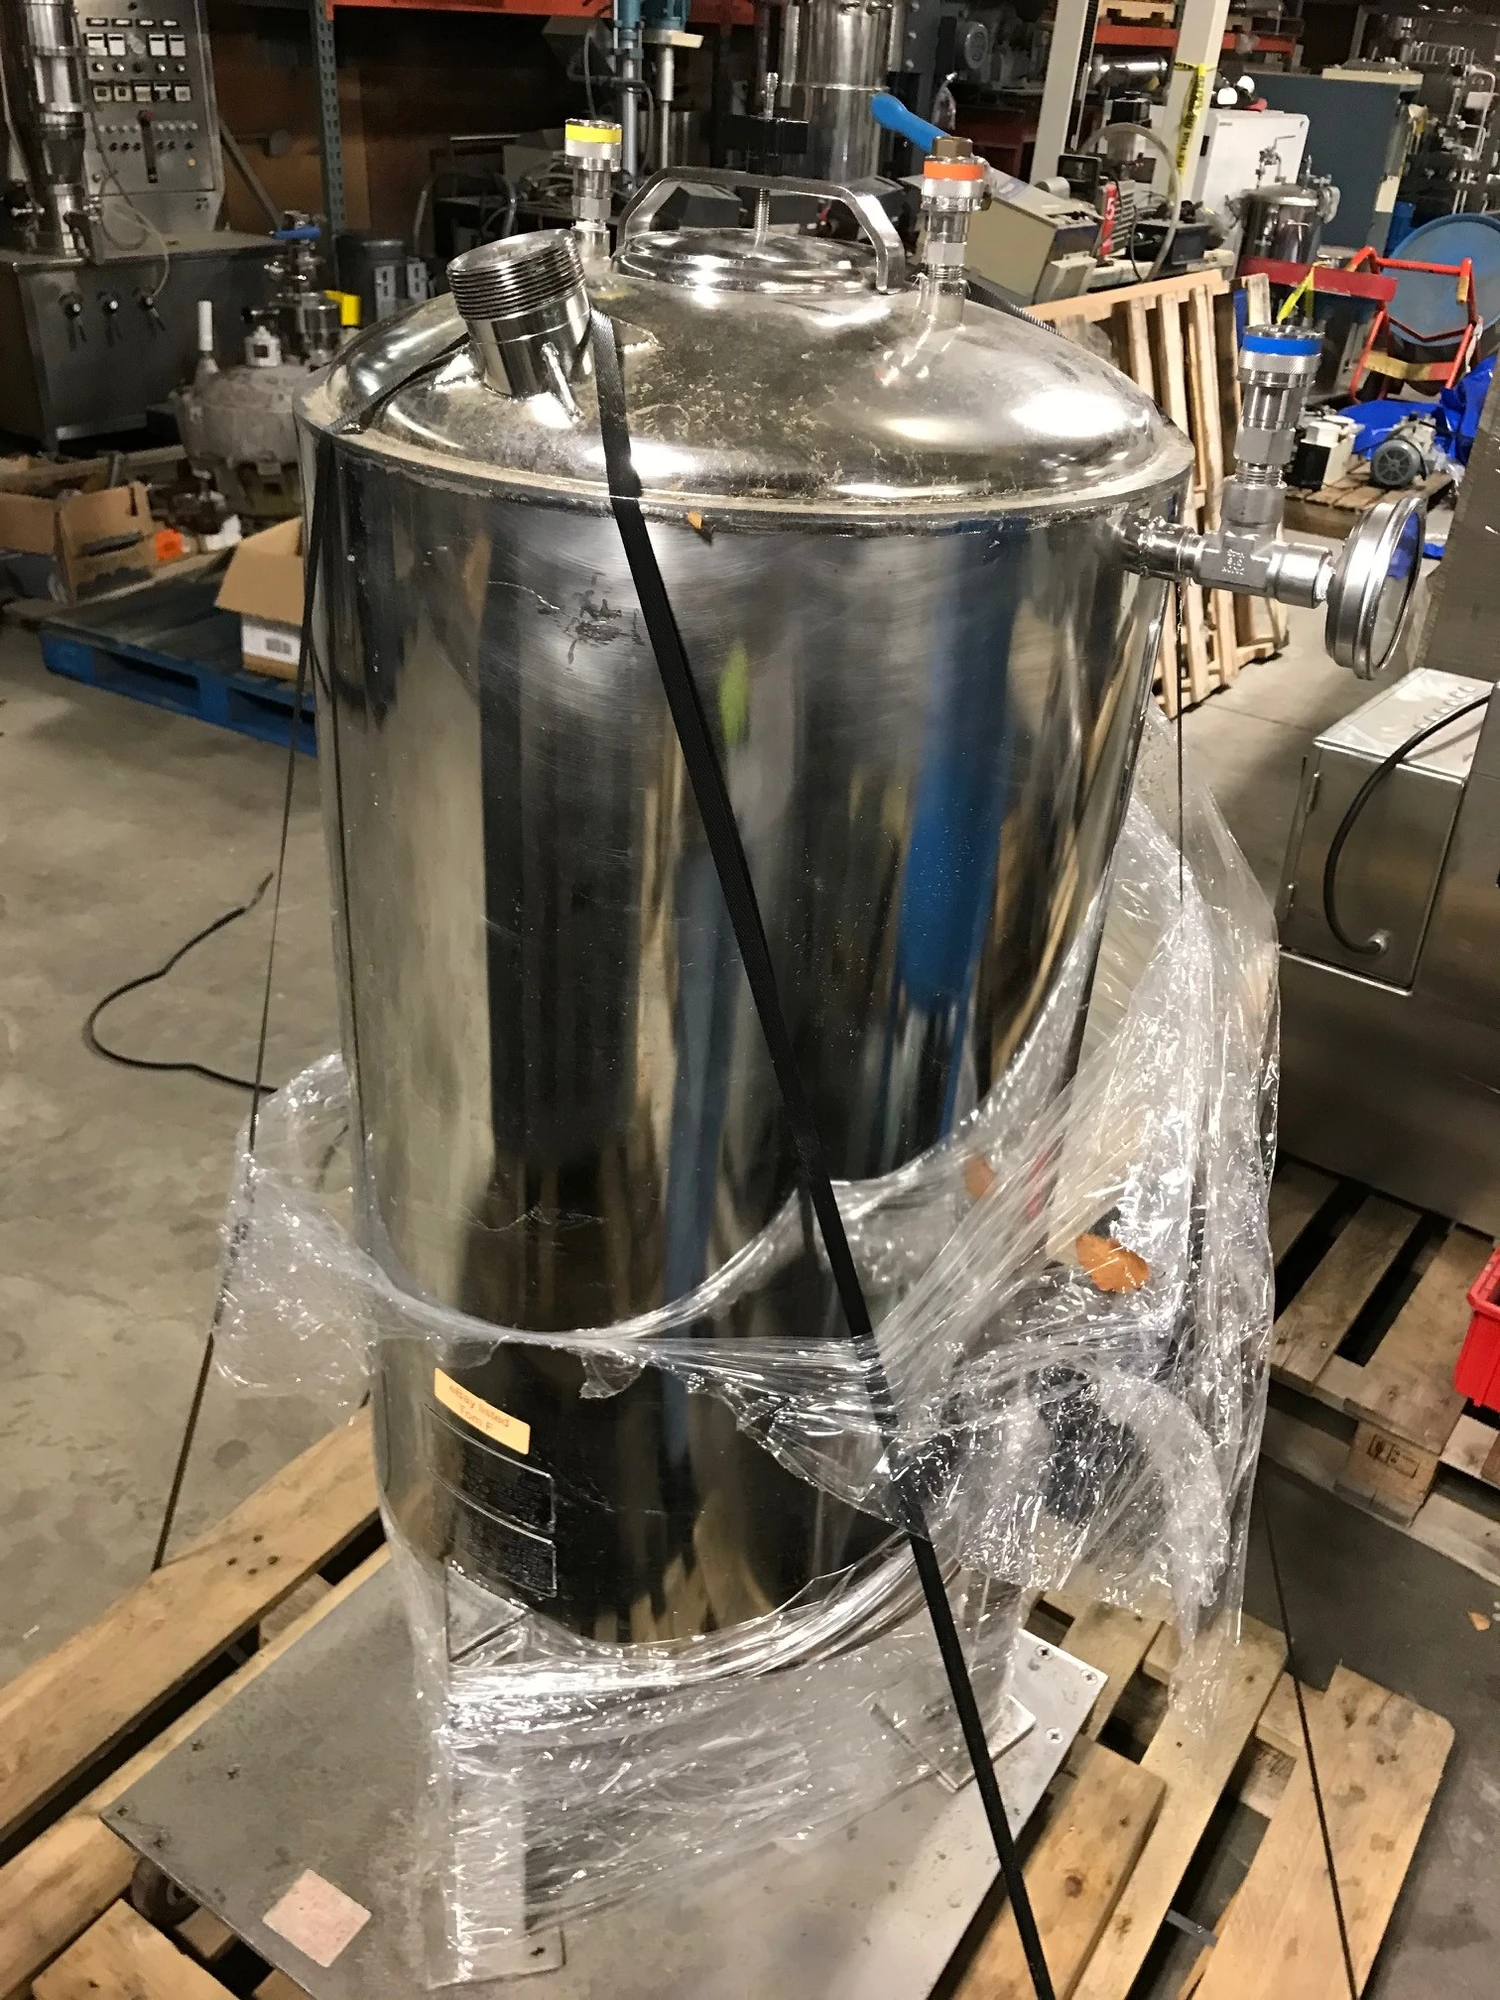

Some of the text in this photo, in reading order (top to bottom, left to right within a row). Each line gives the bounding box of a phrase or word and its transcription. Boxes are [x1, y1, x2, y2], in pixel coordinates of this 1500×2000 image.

[459, 1403, 494, 1431] Tom F
[479, 1402, 510, 1428] listed
